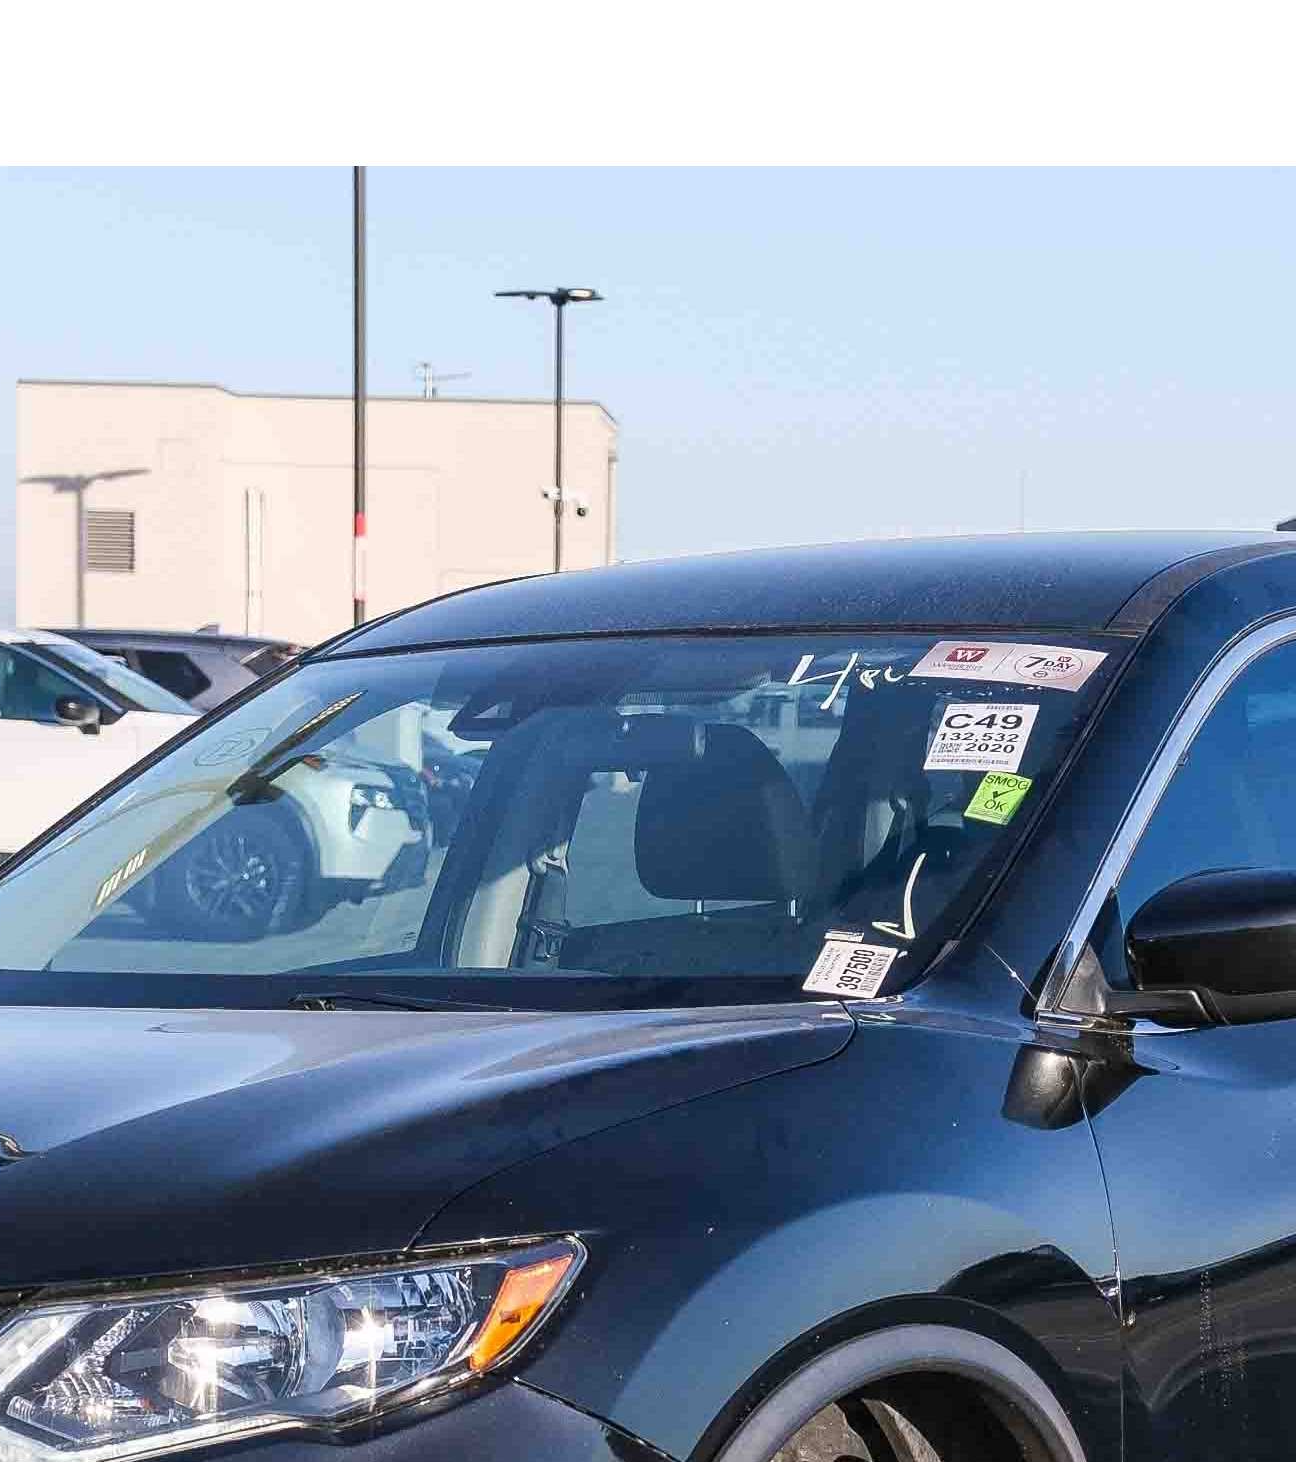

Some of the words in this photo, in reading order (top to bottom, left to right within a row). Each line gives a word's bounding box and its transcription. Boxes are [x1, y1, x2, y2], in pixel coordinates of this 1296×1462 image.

[1024, 656, 1047, 668] 7
[1044, 660, 1074, 669] DAY
[945, 714, 1023, 729] C49
[939, 732, 1019, 743] 132,532
[964, 743, 1015, 753] 2020
[985, 775, 1029, 790] SMOG
[984, 799, 1008, 812] OK
[836, 949, 875, 990] 397500
